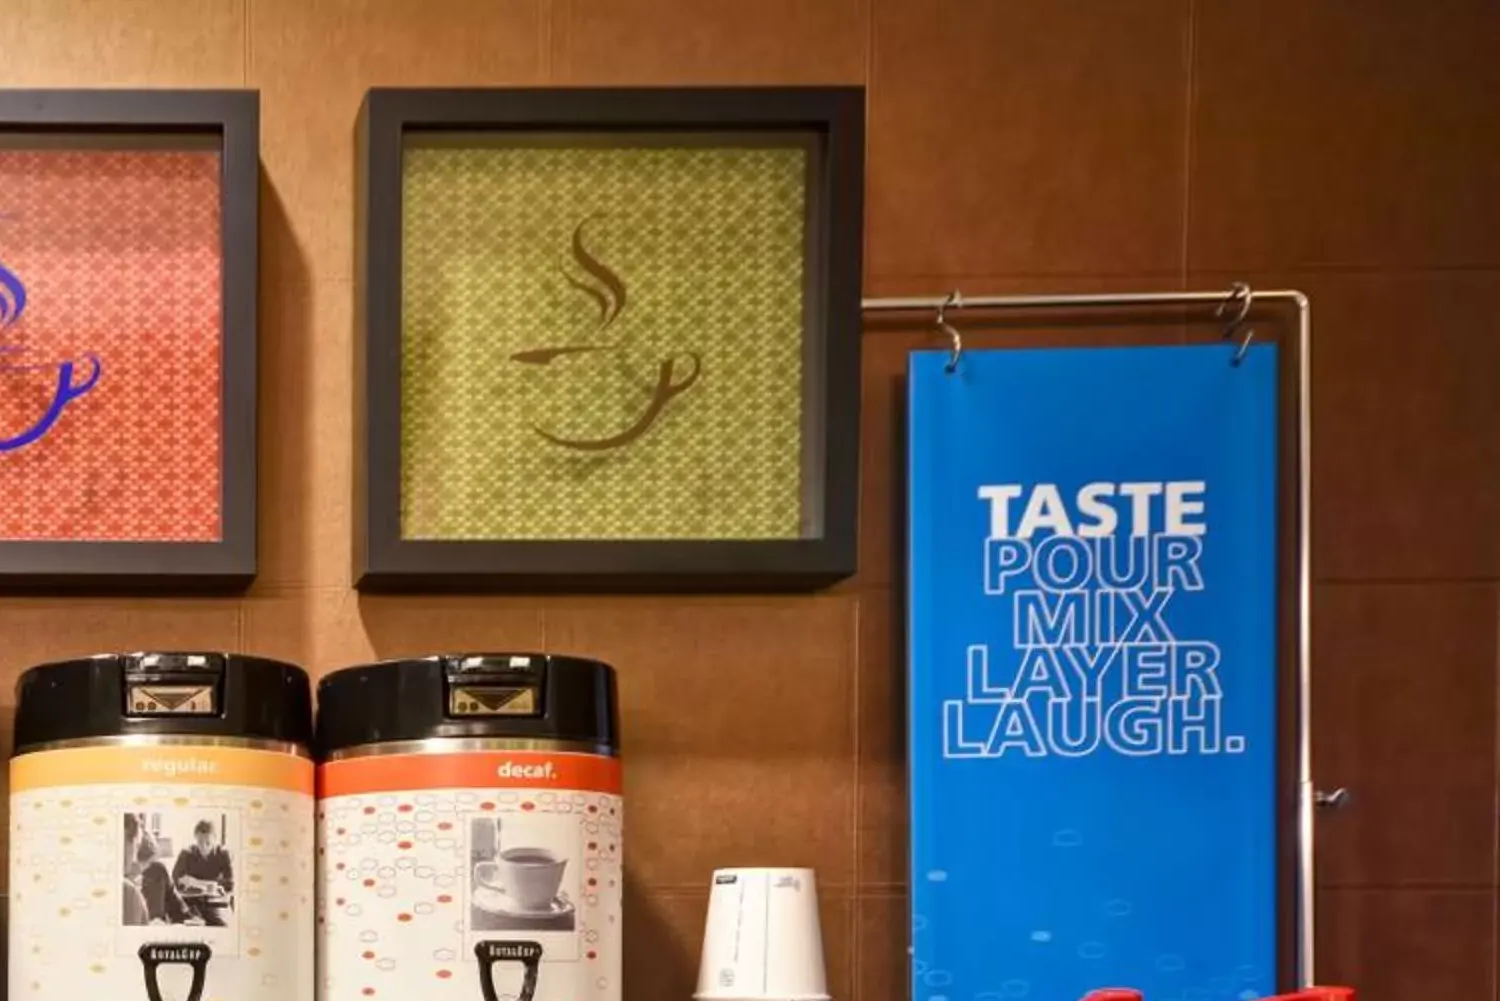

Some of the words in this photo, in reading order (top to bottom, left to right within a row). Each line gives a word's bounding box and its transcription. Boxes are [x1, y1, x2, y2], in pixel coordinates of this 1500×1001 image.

[977, 481, 1207, 540] TASTE
[983, 533, 1205, 595] POUR
[1013, 587, 1175, 649] MIX
[966, 641, 1224, 704] LAYER
[942, 696, 1246, 759] LAUGH.
[497, 760, 558, 779] decaf.
